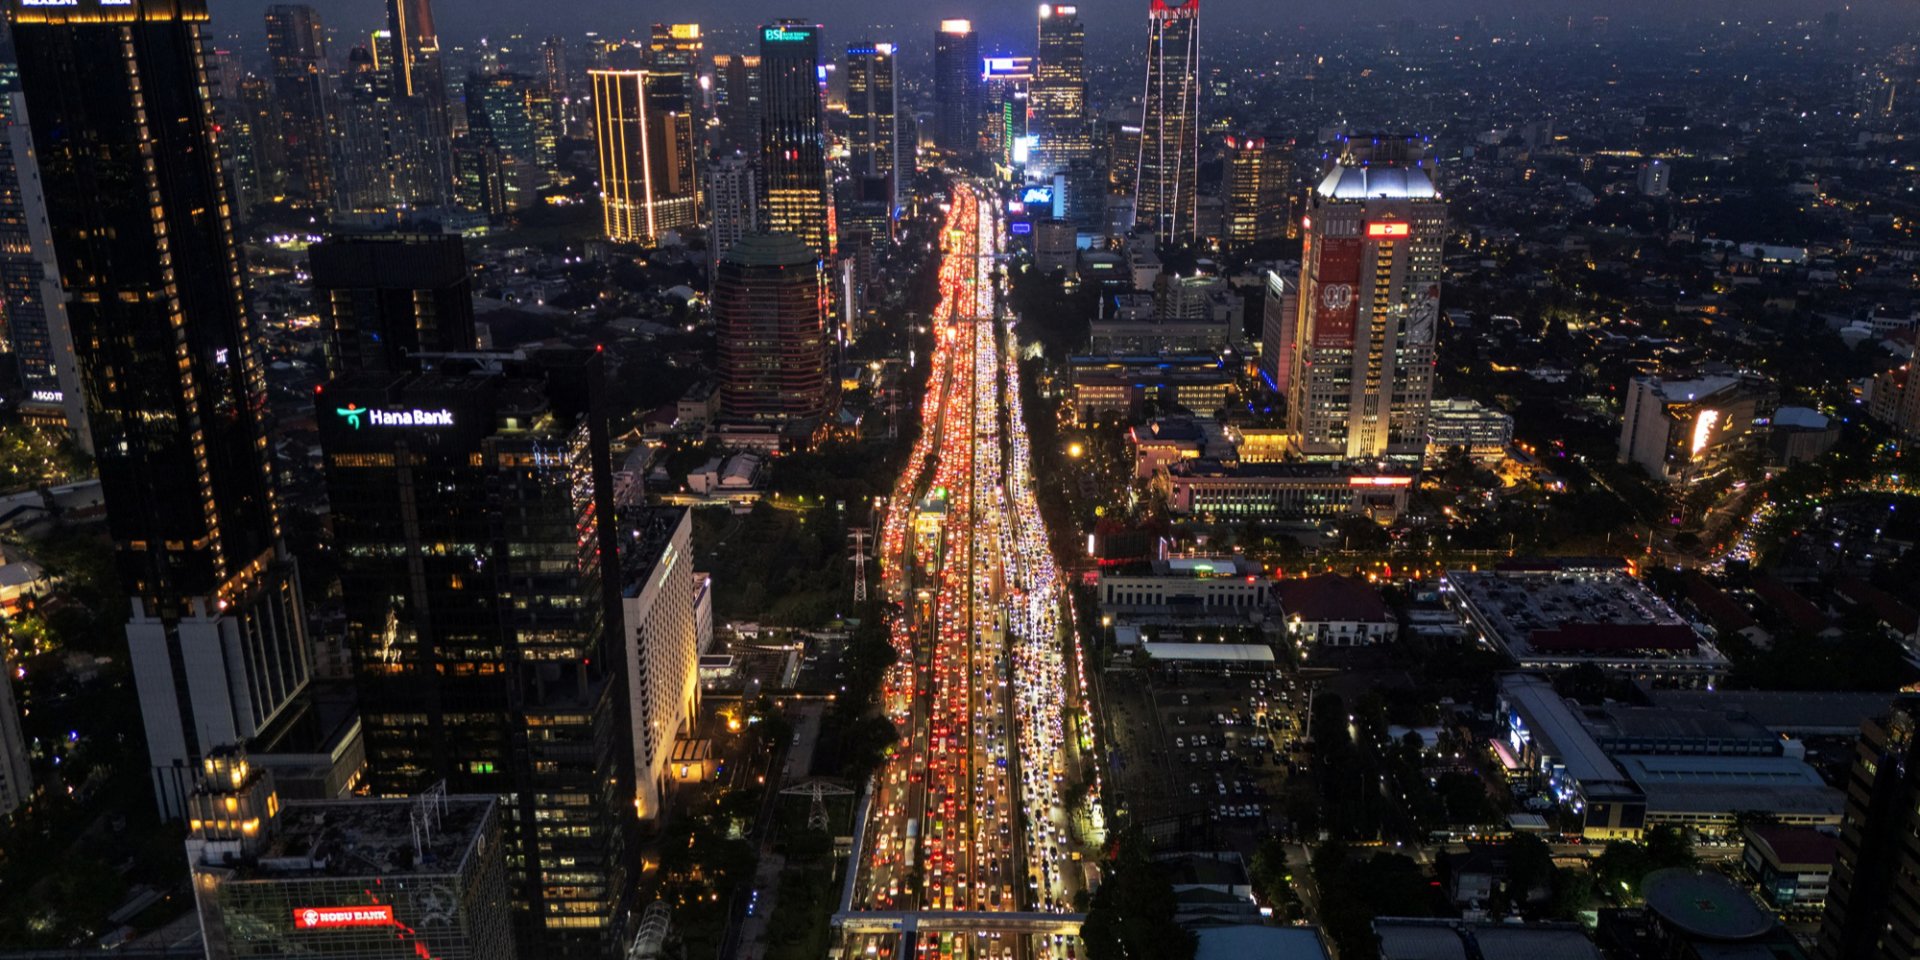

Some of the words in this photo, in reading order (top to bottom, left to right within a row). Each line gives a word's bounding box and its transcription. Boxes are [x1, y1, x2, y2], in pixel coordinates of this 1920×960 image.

[765, 29, 783, 41] BSI
[32, 391, 64, 402] ASCOTT
[370, 409, 413, 424] Hana
[414, 409, 454, 424] Bank
[320, 912, 352, 922] NOBU
[355, 911, 387, 921] BANK
